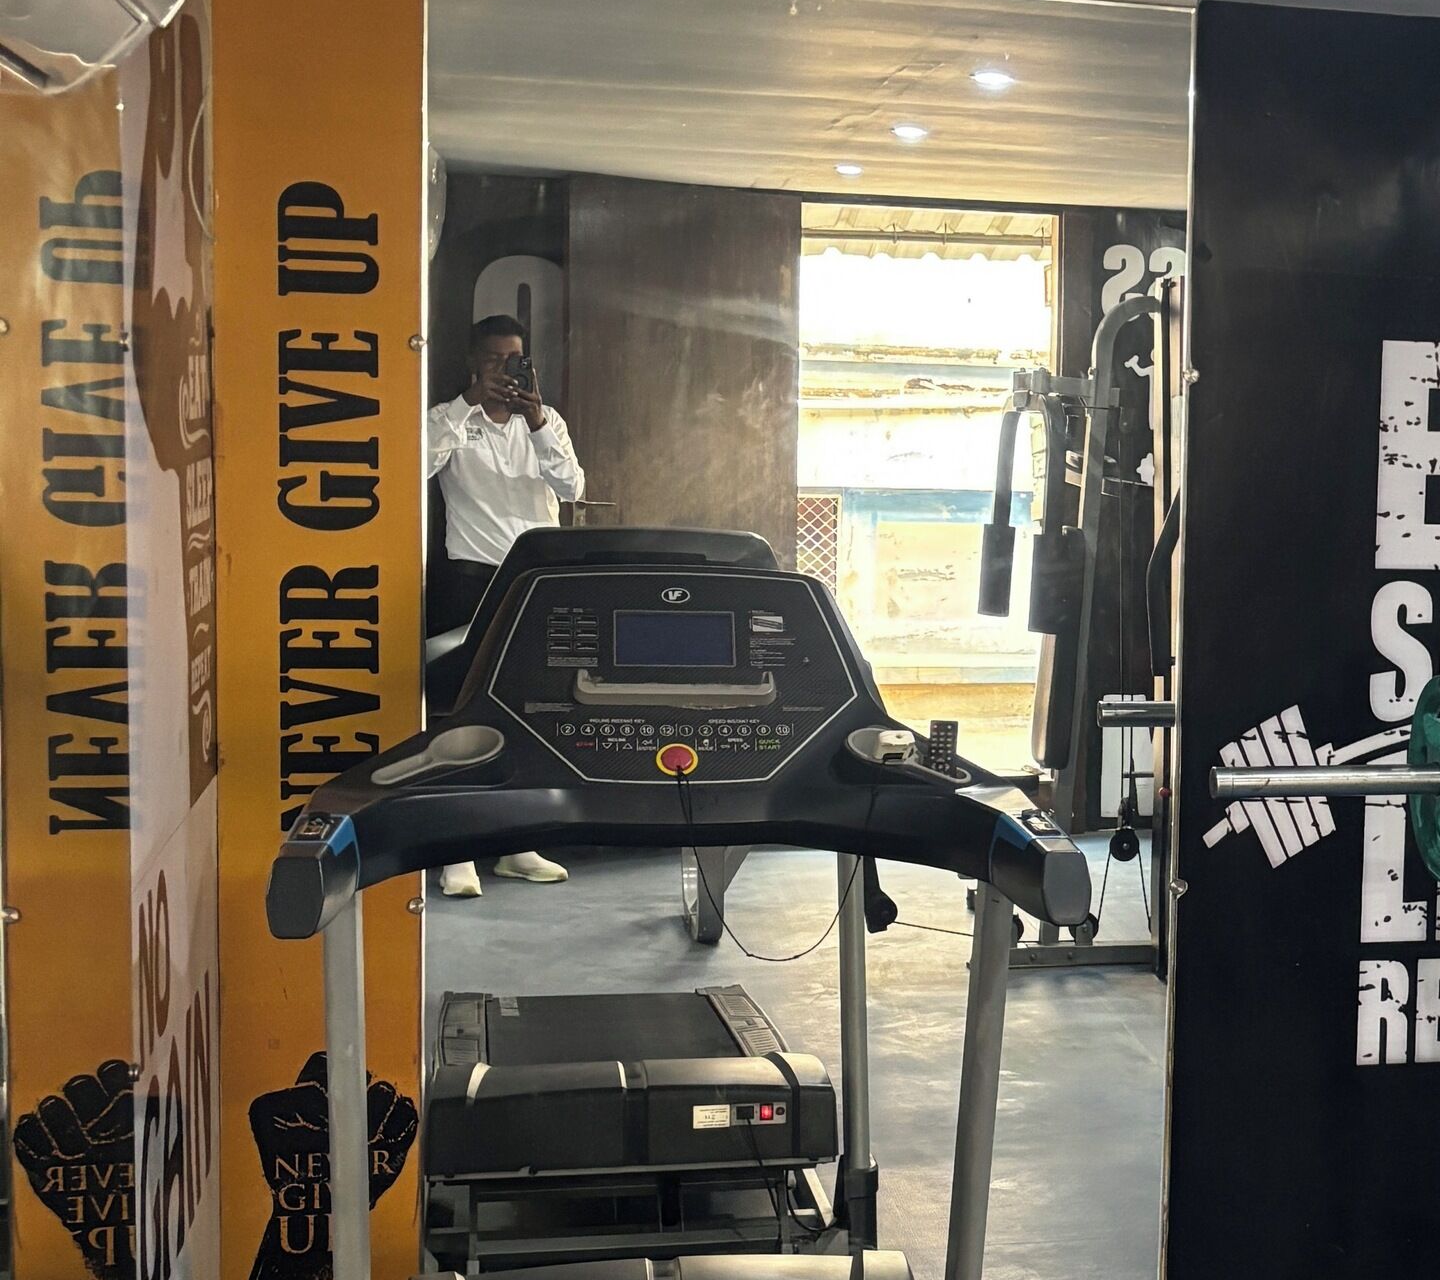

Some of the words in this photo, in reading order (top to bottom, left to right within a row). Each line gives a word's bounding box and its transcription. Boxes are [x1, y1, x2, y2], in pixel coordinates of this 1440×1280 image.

[278, 181, 380, 296] UP
[188, 354, 209, 419] EAT
[278, 329, 380, 531] GIVE
[138, 869, 171, 1072] NO
[274, 1149, 396, 1182] NER
